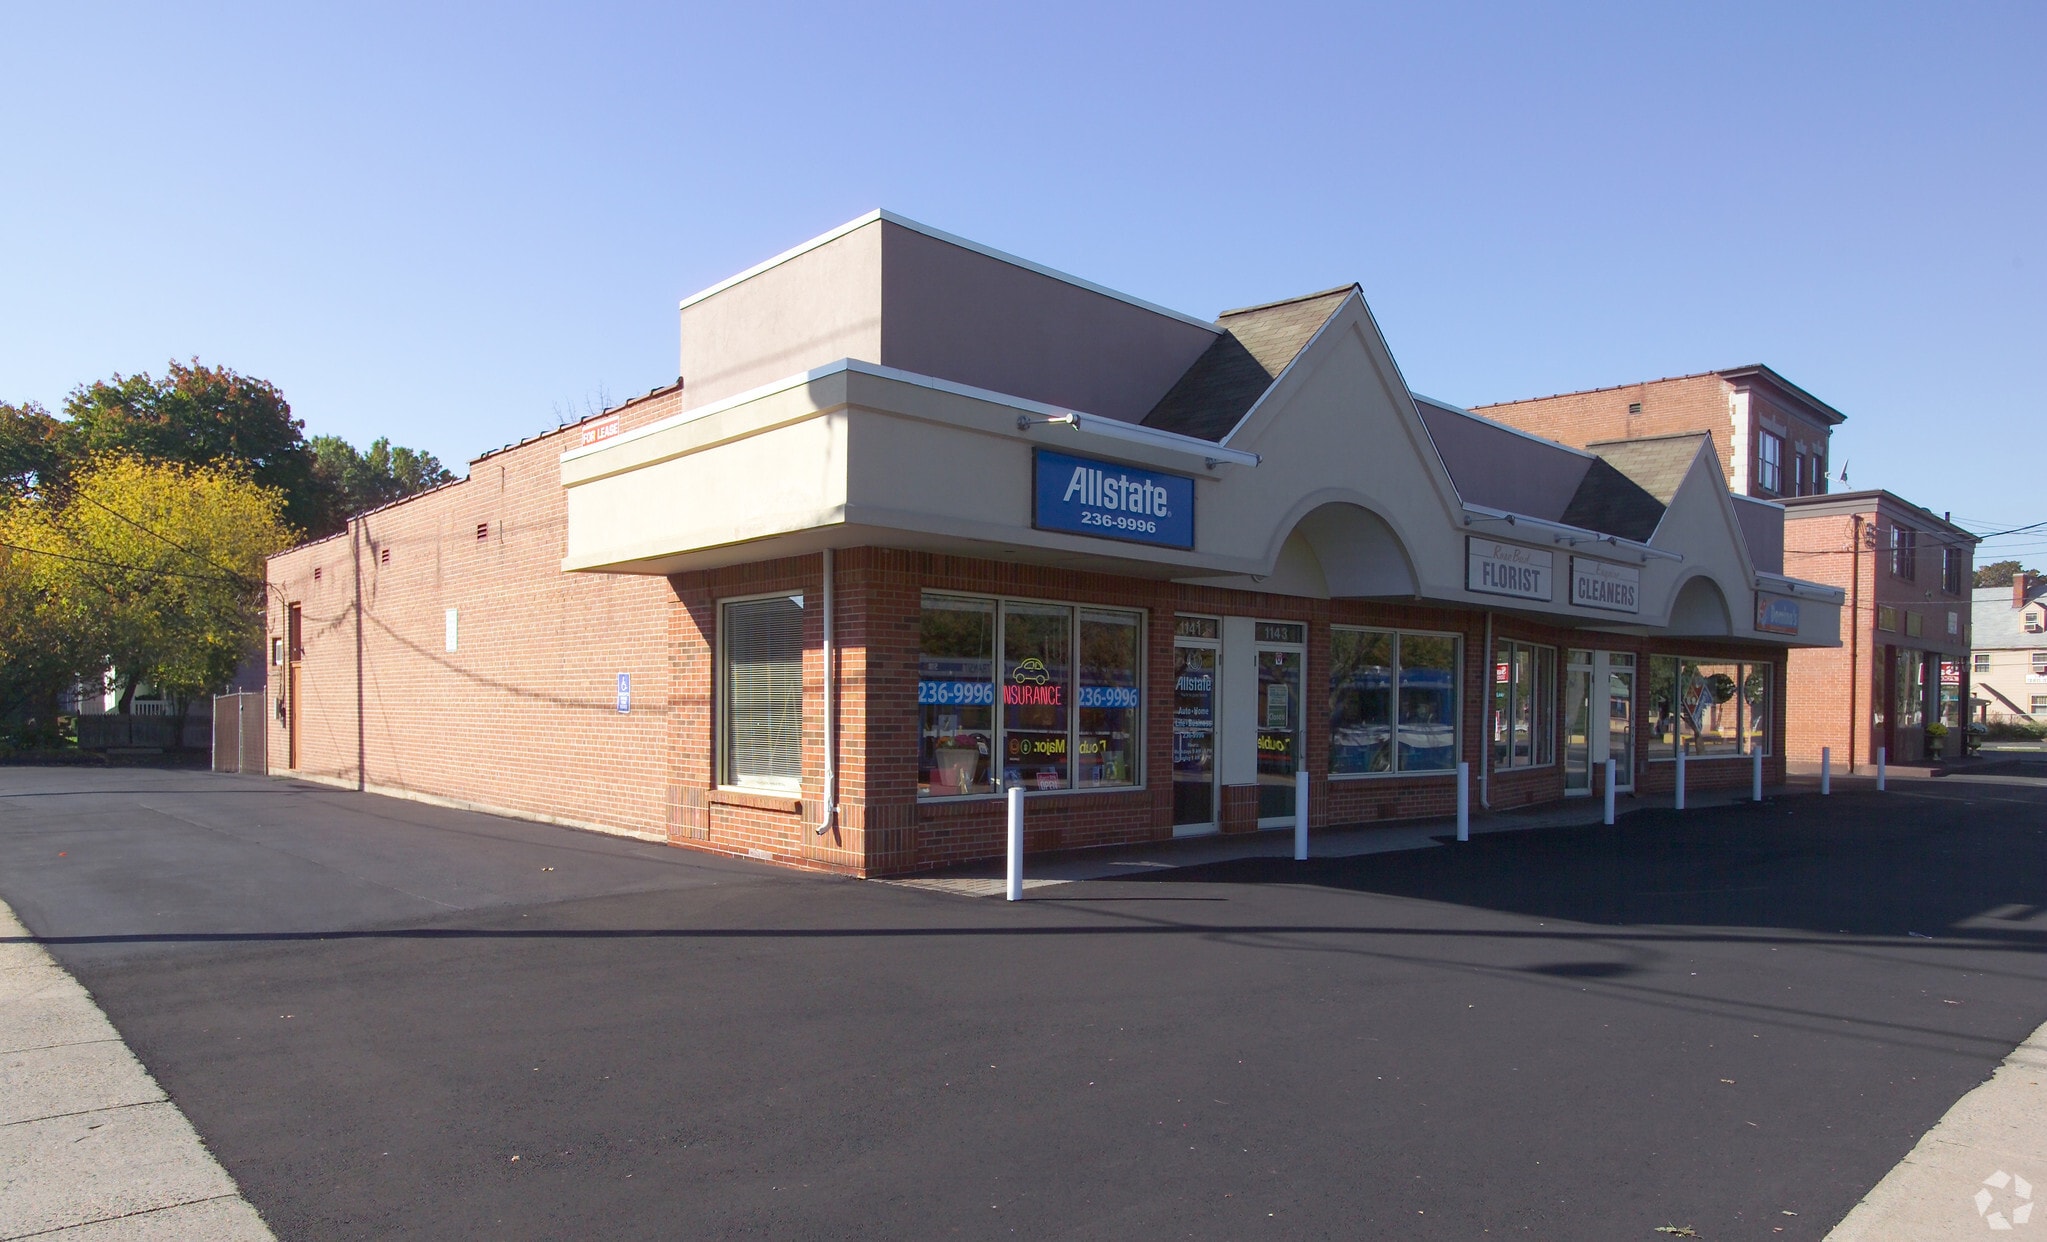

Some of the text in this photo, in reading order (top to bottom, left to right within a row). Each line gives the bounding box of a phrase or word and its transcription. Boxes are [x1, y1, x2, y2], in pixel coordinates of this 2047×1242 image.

[582, 422, 618, 443] FOR LEASE
[1063, 466, 1167, 517] Allstate
[1081, 511, 1156, 533] 236-9996
[1482, 561, 1540, 592] FLORIST
[1578, 577, 1634, 606] CLEANERS
[1180, 620, 1201, 635] 1141
[1265, 626, 1288, 640] 1143
[919, 682, 993, 703] 236-9996
[1175, 676, 1211, 692] Allstate
[1003, 685, 1062, 705] NSURANCE
[1079, 687, 1138, 707] 236-9996
